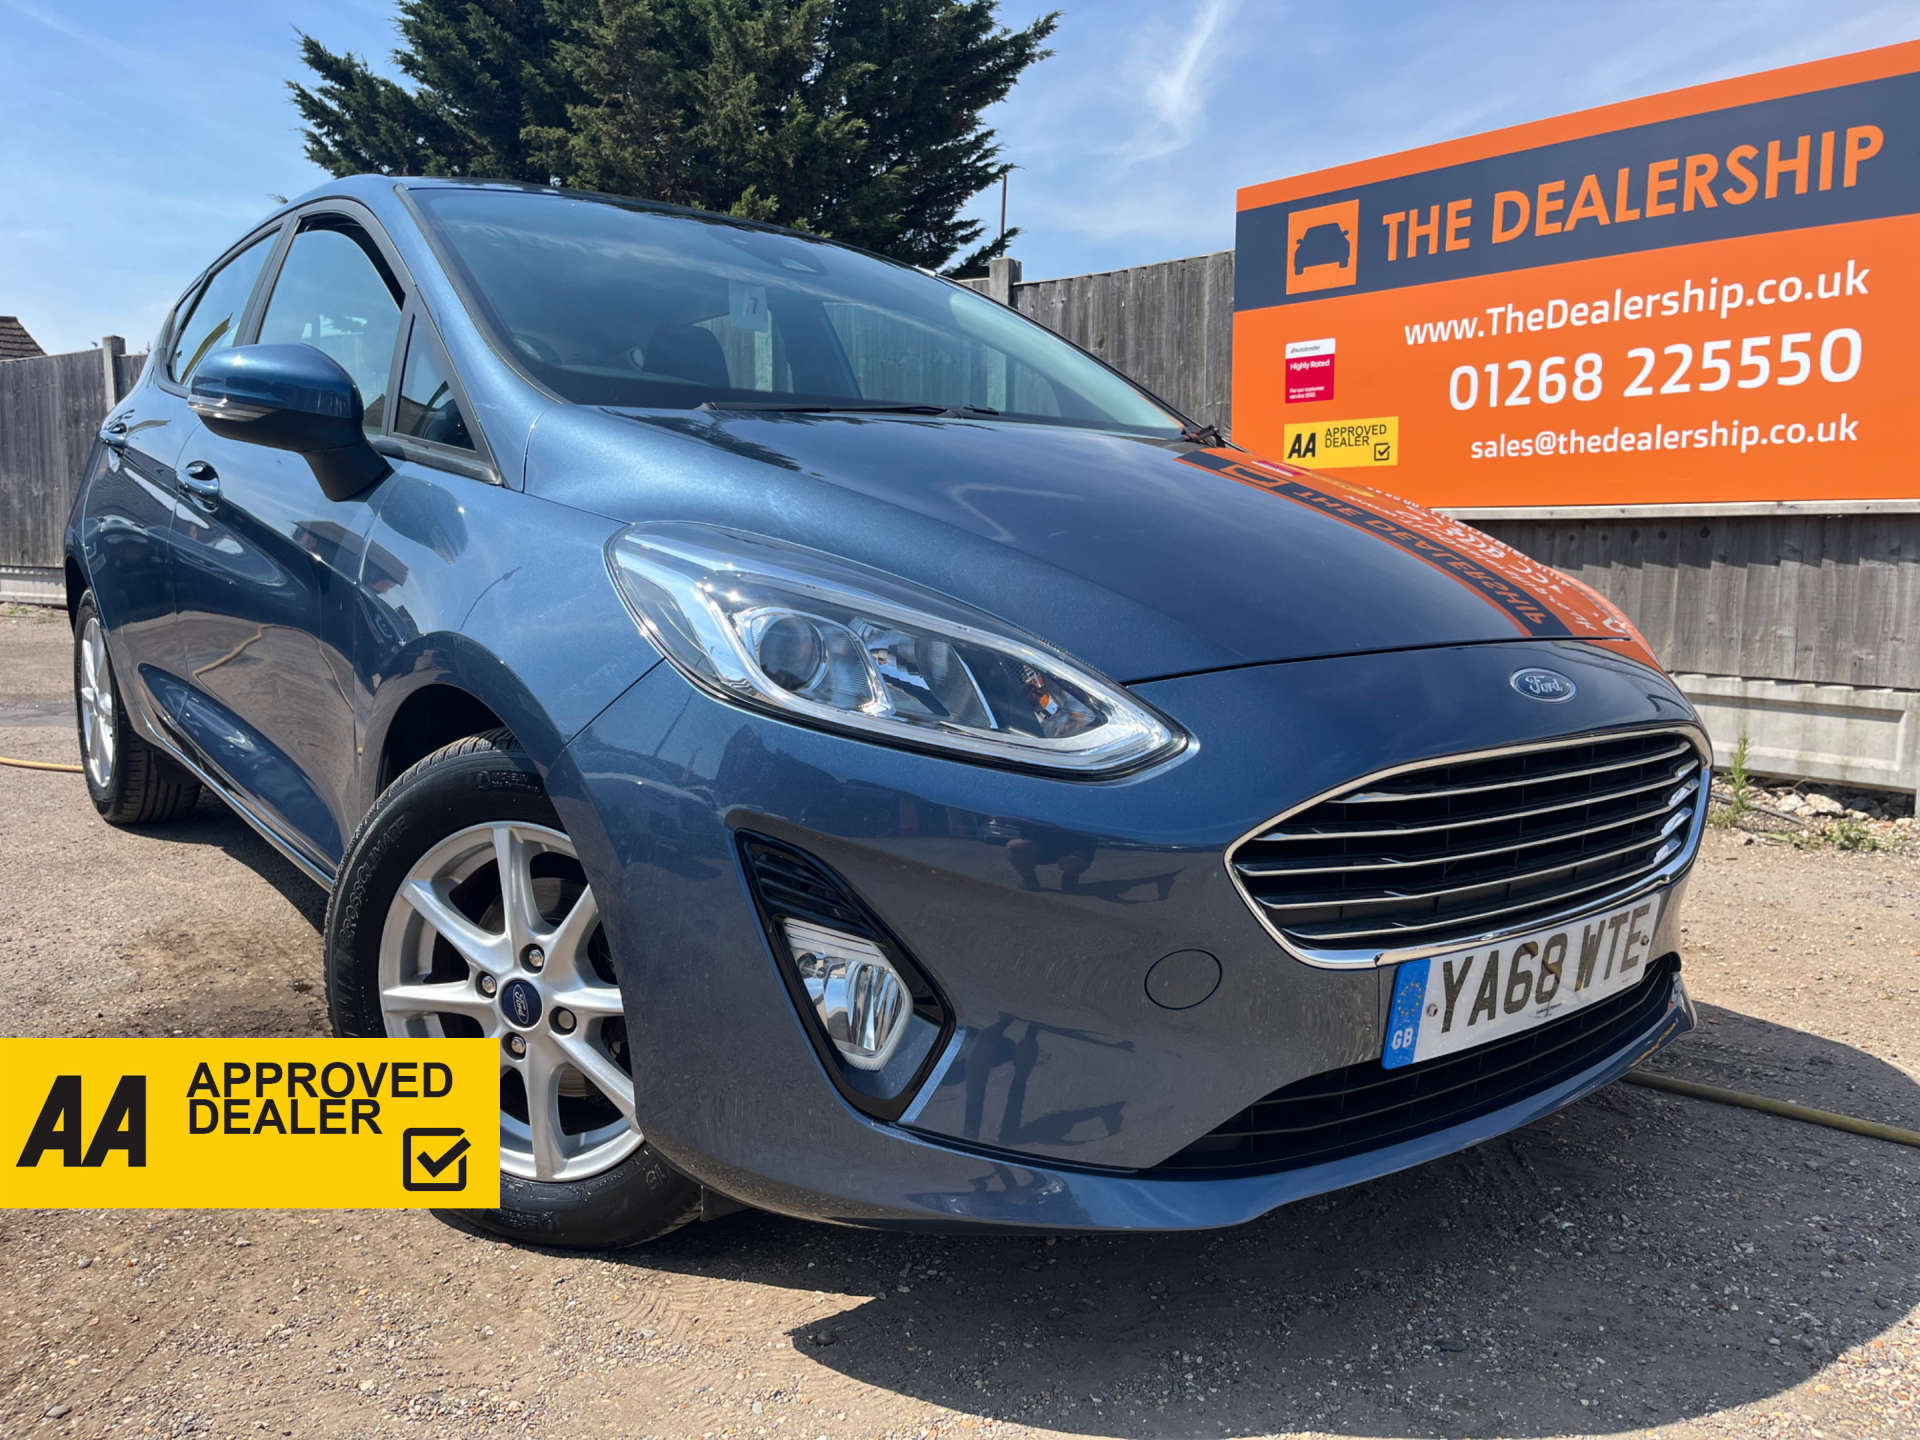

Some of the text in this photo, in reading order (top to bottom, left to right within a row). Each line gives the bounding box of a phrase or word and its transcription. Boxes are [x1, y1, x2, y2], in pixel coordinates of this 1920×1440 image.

[1382, 124, 1884, 262] THE DEALERSHIP
[1404, 259, 1870, 346] www.TheDealership.co.uk
[1449, 327, 1863, 411] 01268 225550
[1325, 424, 1387, 437] APPROVED
[1325, 436, 1370, 448] DEALER
[1471, 412, 1859, 459] sales@thedealership.co.uk
[1287, 432, 1317, 459] AA
[1525, 675, 1563, 694] Ford
[1440, 903, 1651, 1034] YA68 WTE
[514, 991, 526, 1017] Ford
[1391, 1027, 1414, 1051] GB
